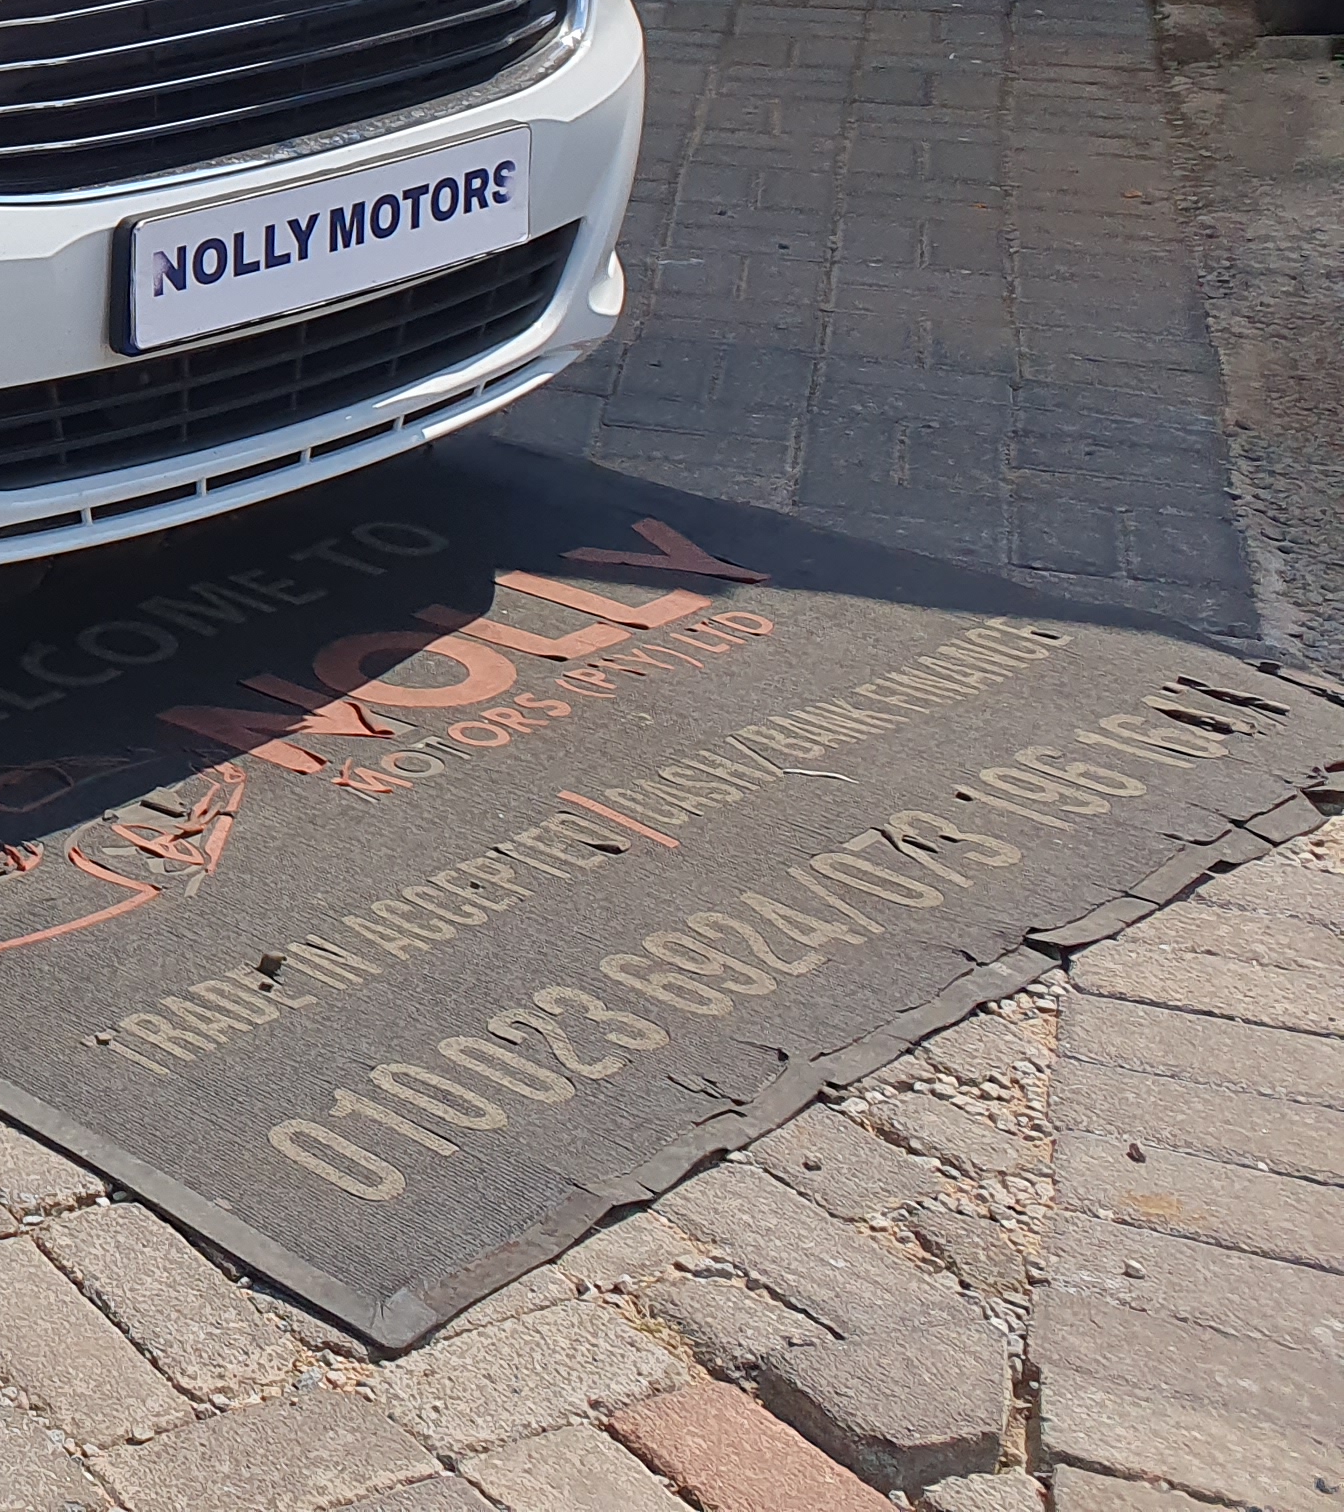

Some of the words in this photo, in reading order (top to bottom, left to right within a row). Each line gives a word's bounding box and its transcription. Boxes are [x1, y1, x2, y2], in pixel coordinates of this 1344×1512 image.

[152, 212, 321, 297] NOLLY
[328, 159, 517, 253] MOTORS
[290, 521, 450, 578] TO
[155, 517, 772, 777] NOLLY
[853, 617, 1075, 715] FINANCE
